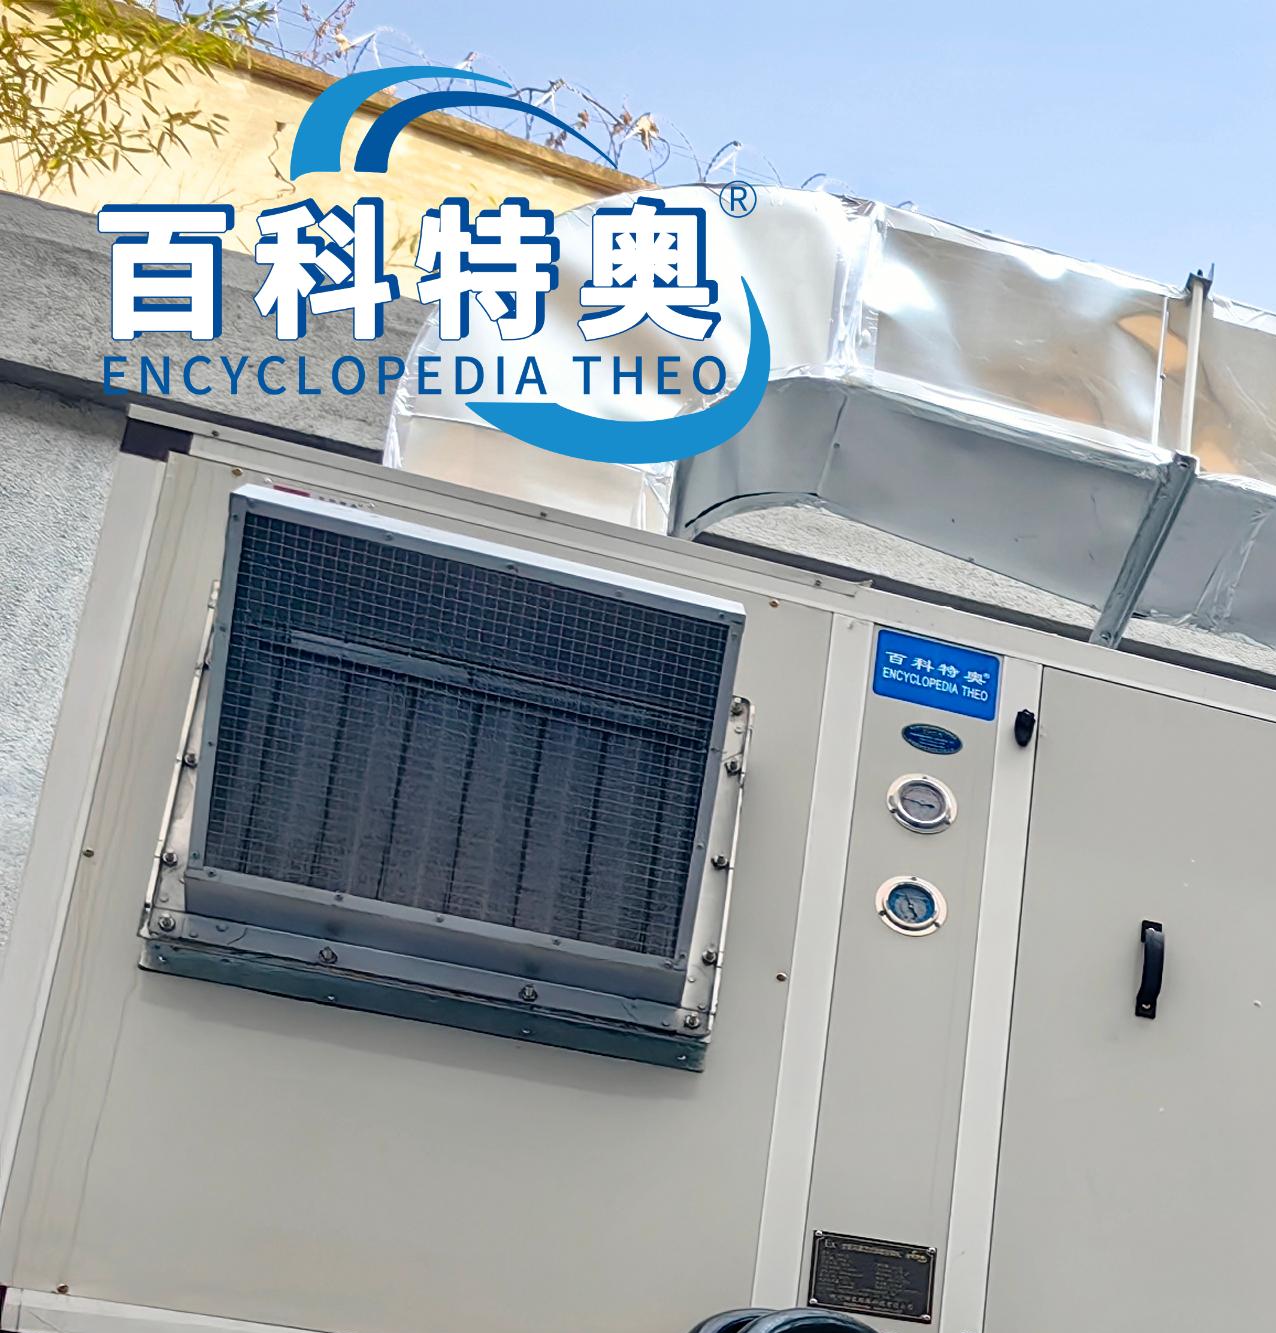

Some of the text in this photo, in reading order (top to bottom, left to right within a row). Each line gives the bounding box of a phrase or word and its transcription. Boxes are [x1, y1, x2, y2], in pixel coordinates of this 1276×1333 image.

[882, 667, 988, 702] ENCYCLOPEDIA THEO
[885, 651, 986, 684] 百科特奥
